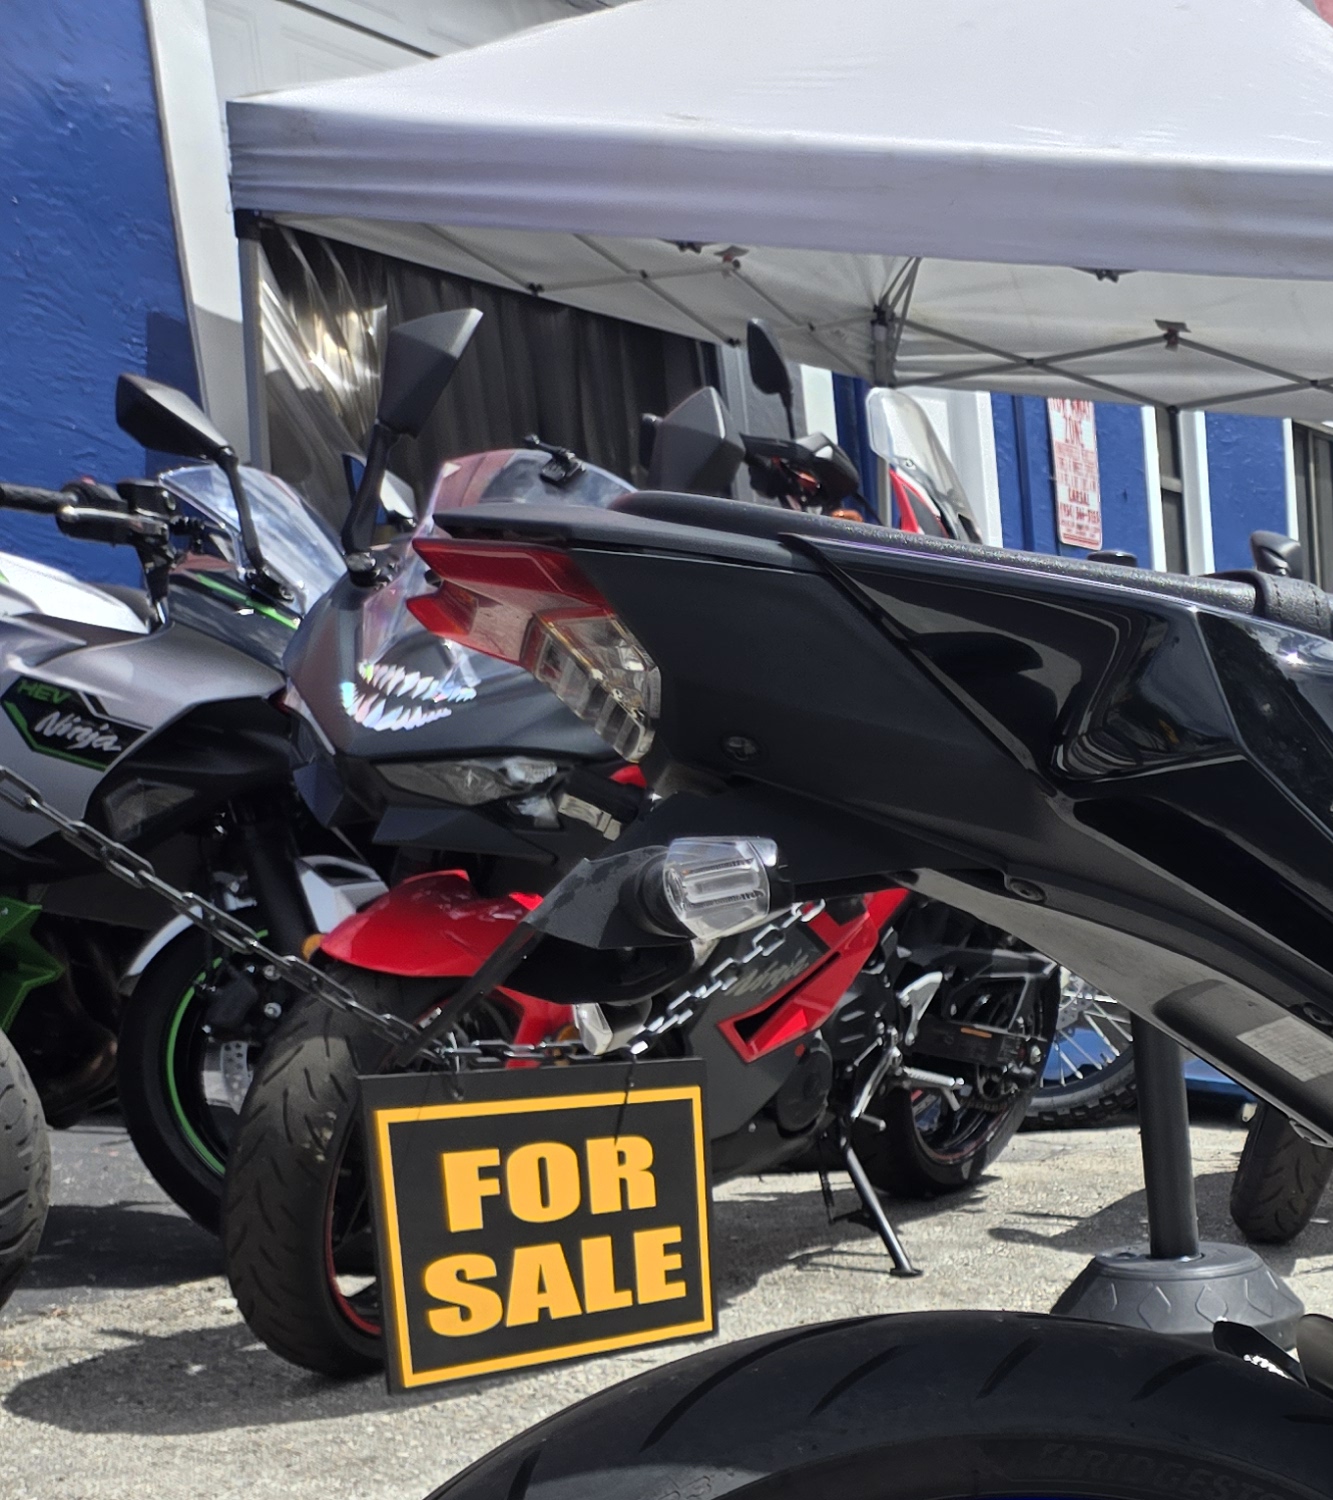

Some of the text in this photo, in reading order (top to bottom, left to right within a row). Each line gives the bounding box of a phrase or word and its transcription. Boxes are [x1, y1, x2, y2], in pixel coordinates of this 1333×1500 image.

[17, 680, 73, 704] HEV
[34, 711, 122, 751] Ninja
[442, 1136, 656, 1233] FOR
[424, 1225, 687, 1337] SALE
